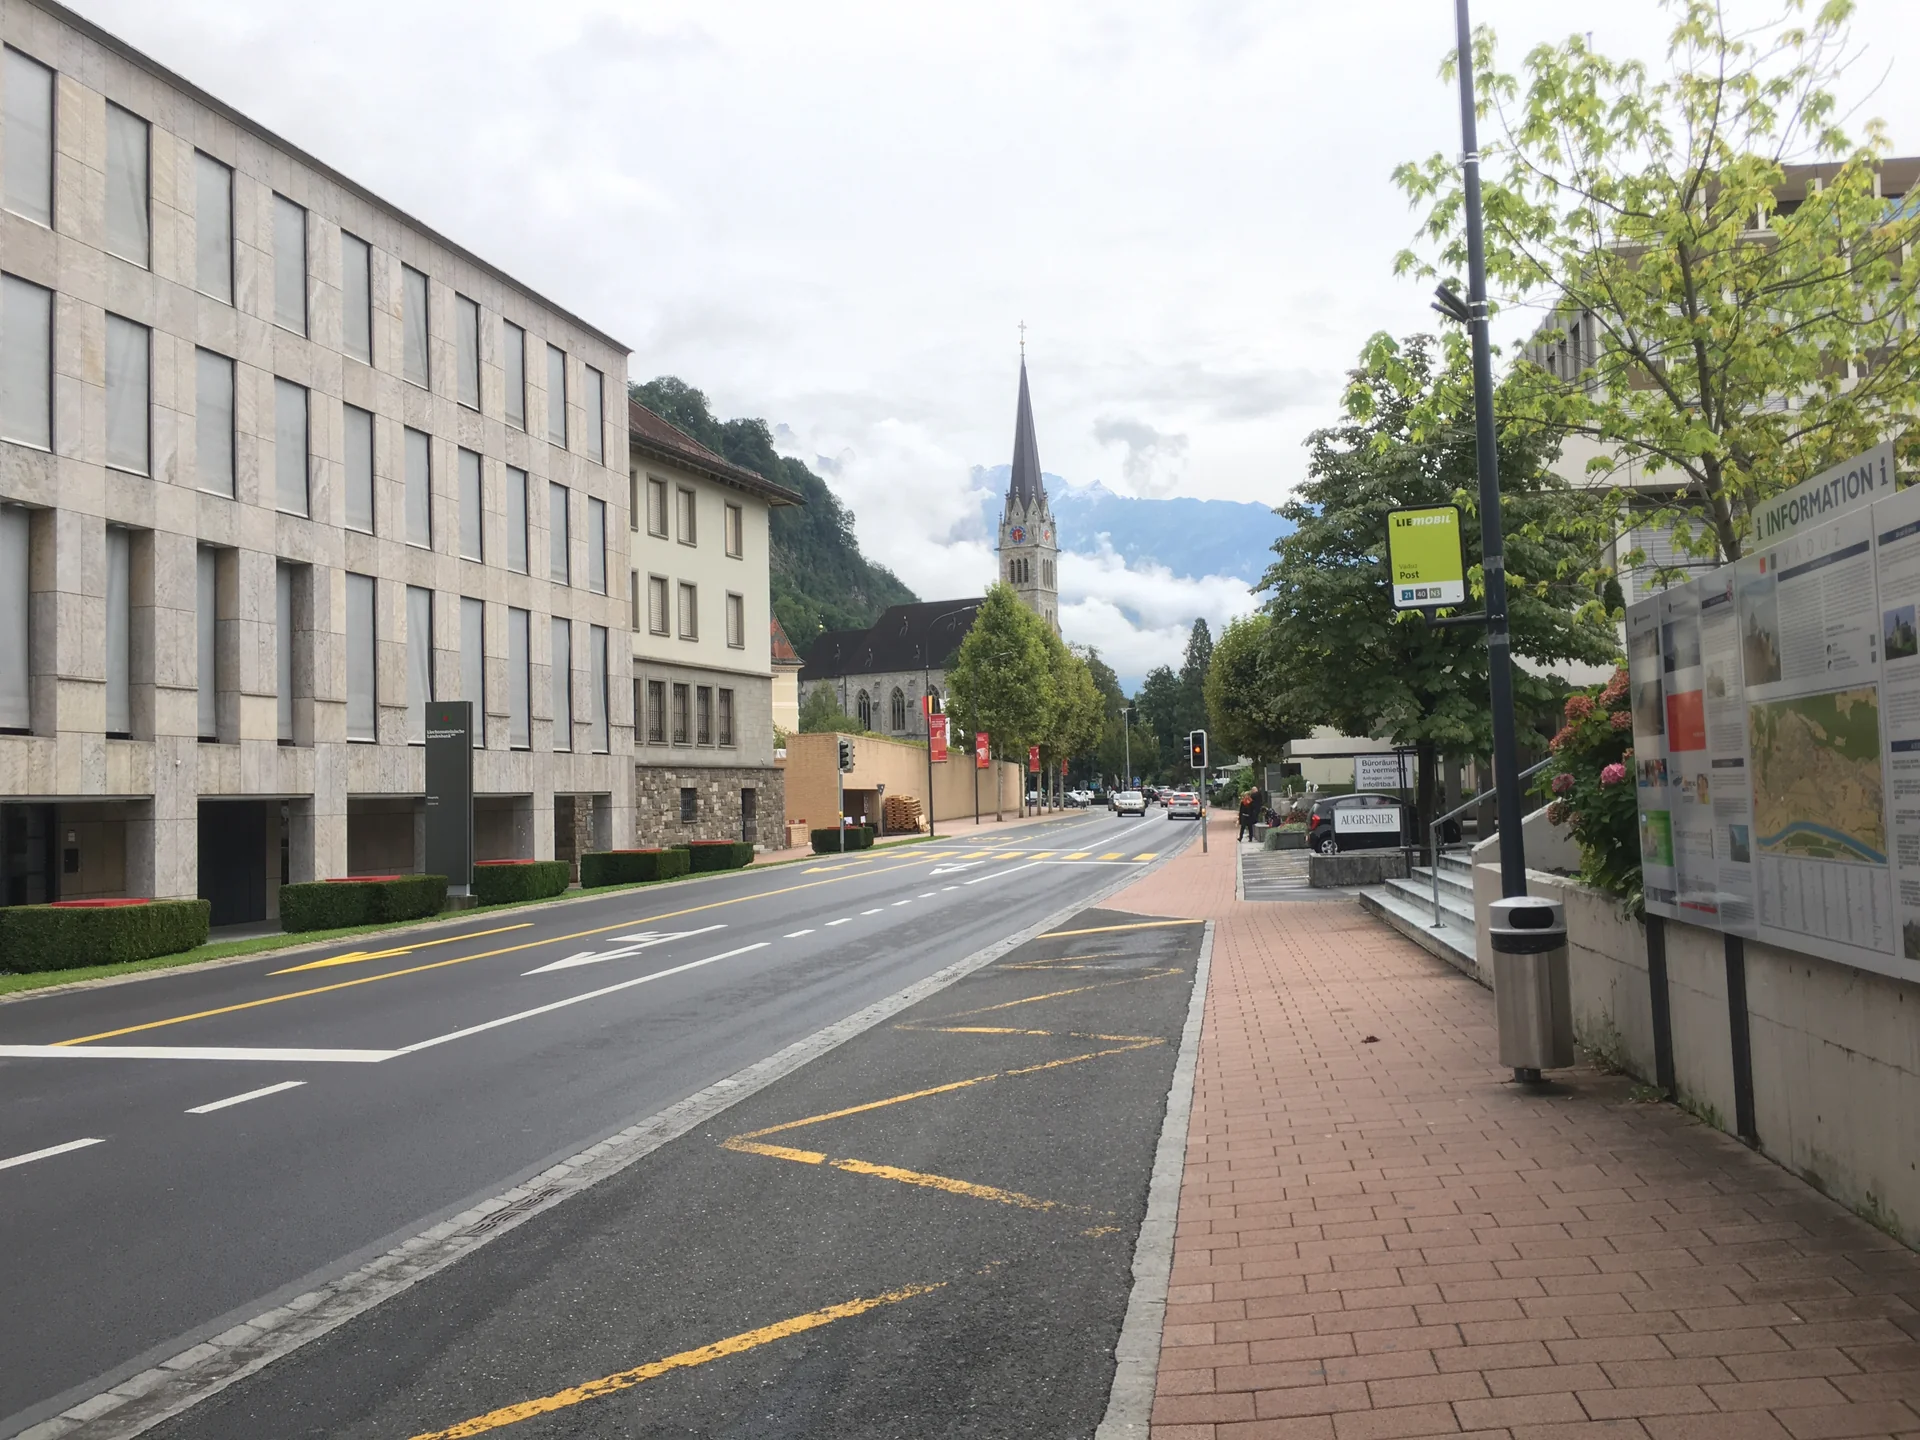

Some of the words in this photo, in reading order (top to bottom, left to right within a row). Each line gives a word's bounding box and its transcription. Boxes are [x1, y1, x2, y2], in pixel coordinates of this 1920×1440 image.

[1766, 463, 1874, 537] INFORMATION
[1783, 527, 1842, 565] VADUZ
[1400, 571, 1419, 579] Post
[1341, 814, 1394, 824] AUGRENIER
